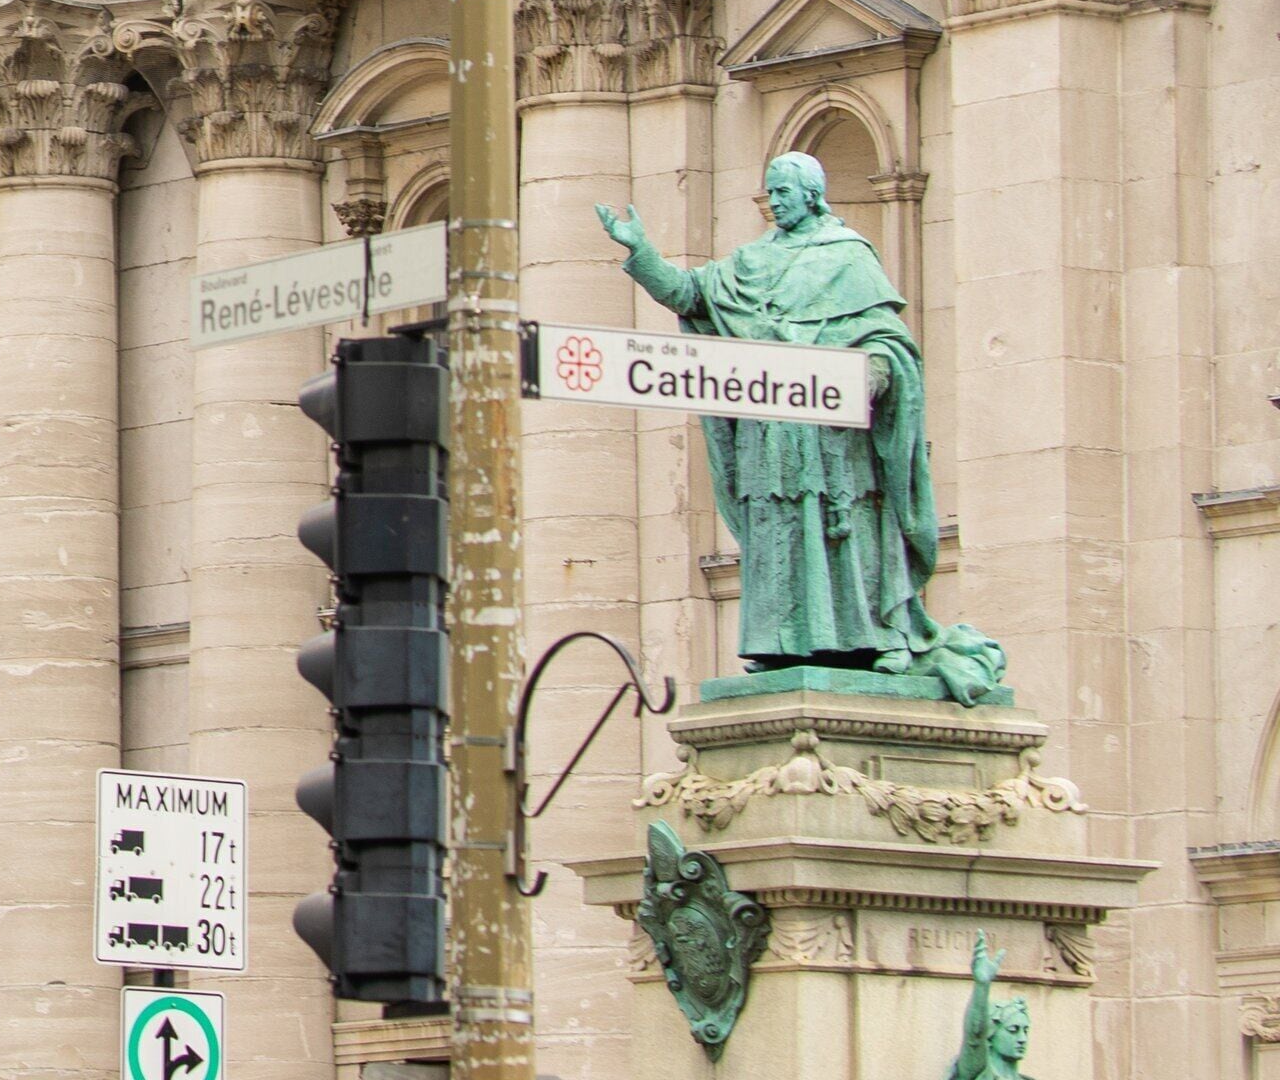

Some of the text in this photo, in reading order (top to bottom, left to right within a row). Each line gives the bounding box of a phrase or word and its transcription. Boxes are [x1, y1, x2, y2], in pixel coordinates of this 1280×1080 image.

[627, 339, 698, 357] Rue de la
[627, 360, 842, 410] Cathédrale
[116, 783, 228, 816] MAXIMUM
[908, 927, 997, 952] RELIGIN
